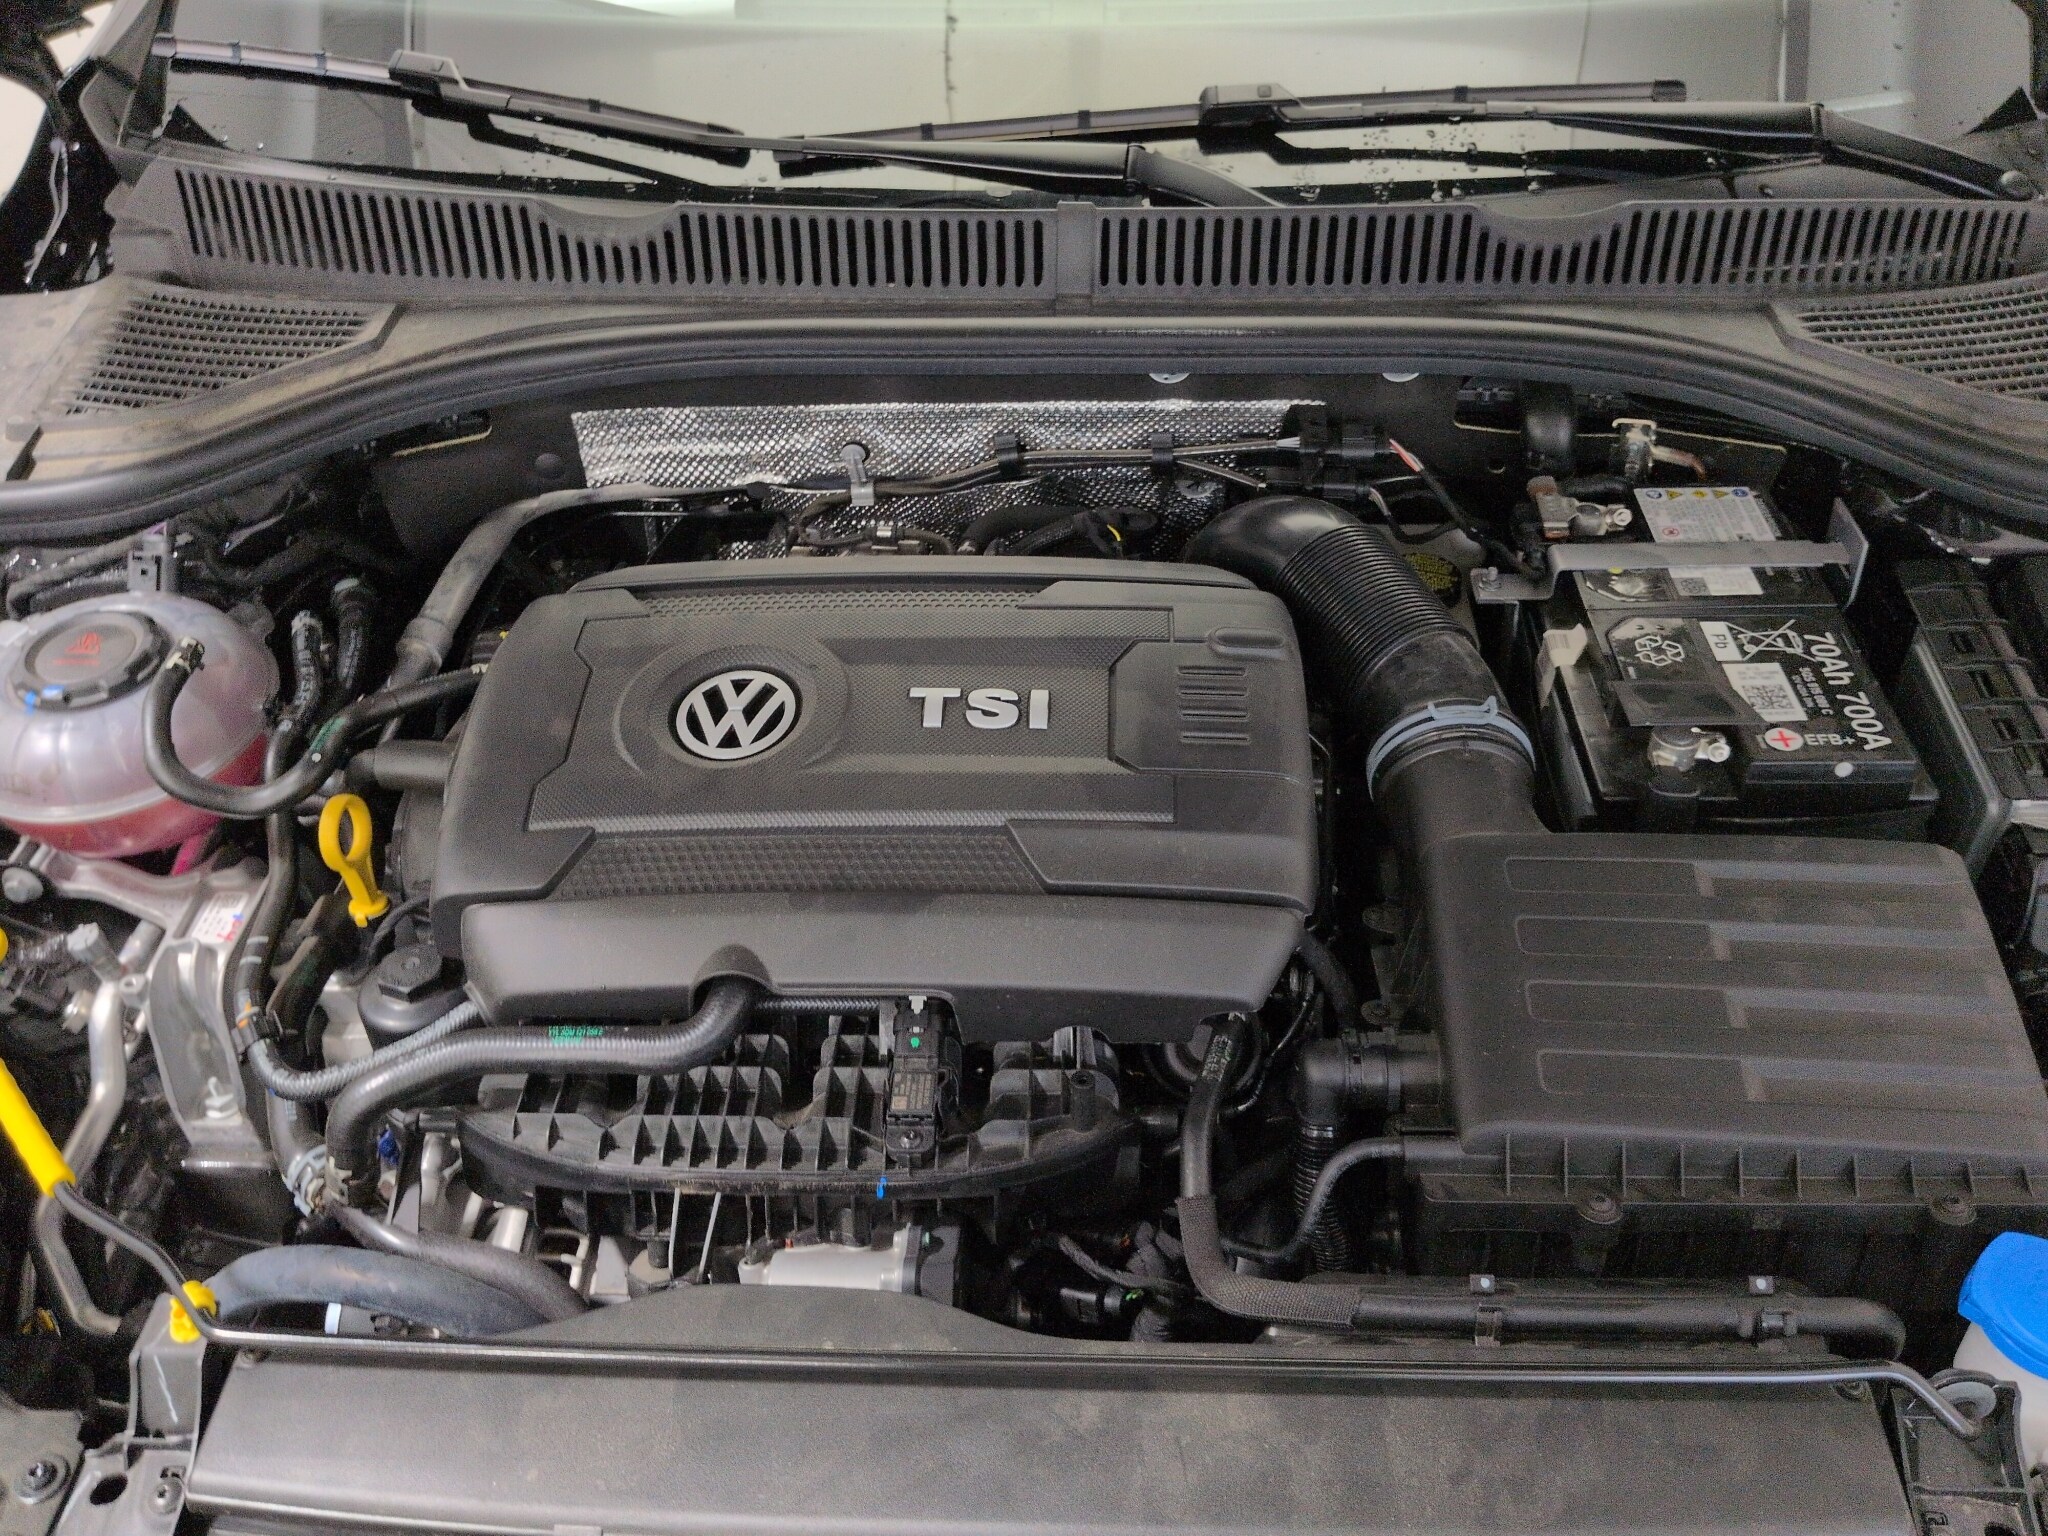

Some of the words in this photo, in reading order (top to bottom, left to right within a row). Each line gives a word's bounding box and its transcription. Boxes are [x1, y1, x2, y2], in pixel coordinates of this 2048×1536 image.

[1711, 634, 1728, 649] Pb
[1804, 632, 1854, 685] 70Ah
[1837, 691, 1892, 750] 700A
[909, 687, 1050, 729] TSI
[1805, 733, 1855, 746] EFB+
